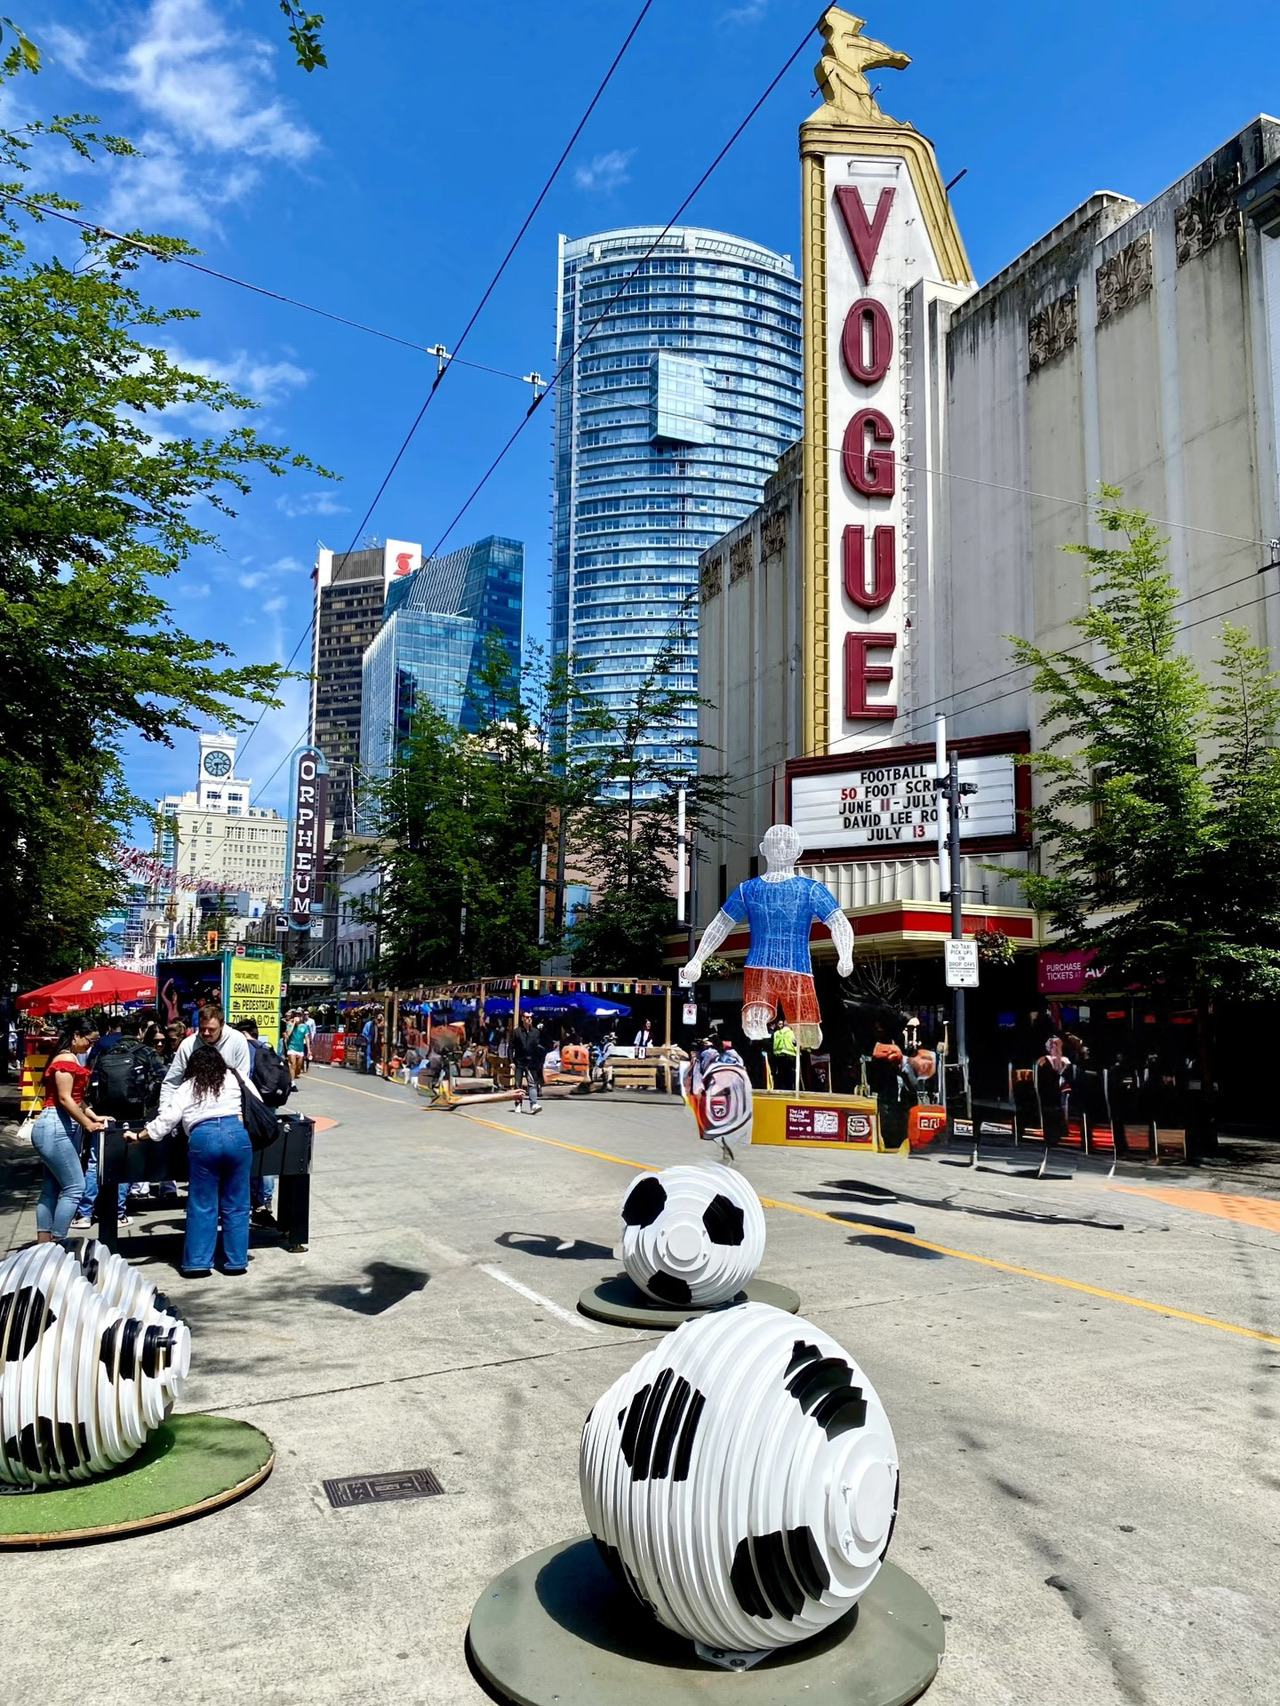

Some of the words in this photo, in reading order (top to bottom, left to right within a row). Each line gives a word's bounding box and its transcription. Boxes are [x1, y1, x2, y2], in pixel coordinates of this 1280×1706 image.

[835, 185, 897, 719] VOGUE
[861, 766, 927, 784] FOOTBALL
[841, 788, 857, 800] 50
[865, 783, 897, 798] FOOT
[839, 800, 872, 815] JUNE
[844, 814, 881, 829] DAVID
[891, 811, 912, 825] LEE
[293, 761, 315, 913] ORPHEUM
[867, 826, 902, 841] JULY
[913, 825, 925, 838] 13
[1046, 962, 1081, 972] PURCHASE
[1046, 971, 1073, 980] TICKETS
[234, 983, 264, 994] GRANVILLE
[242, 1000, 274, 1010] PEDESTRIAN
